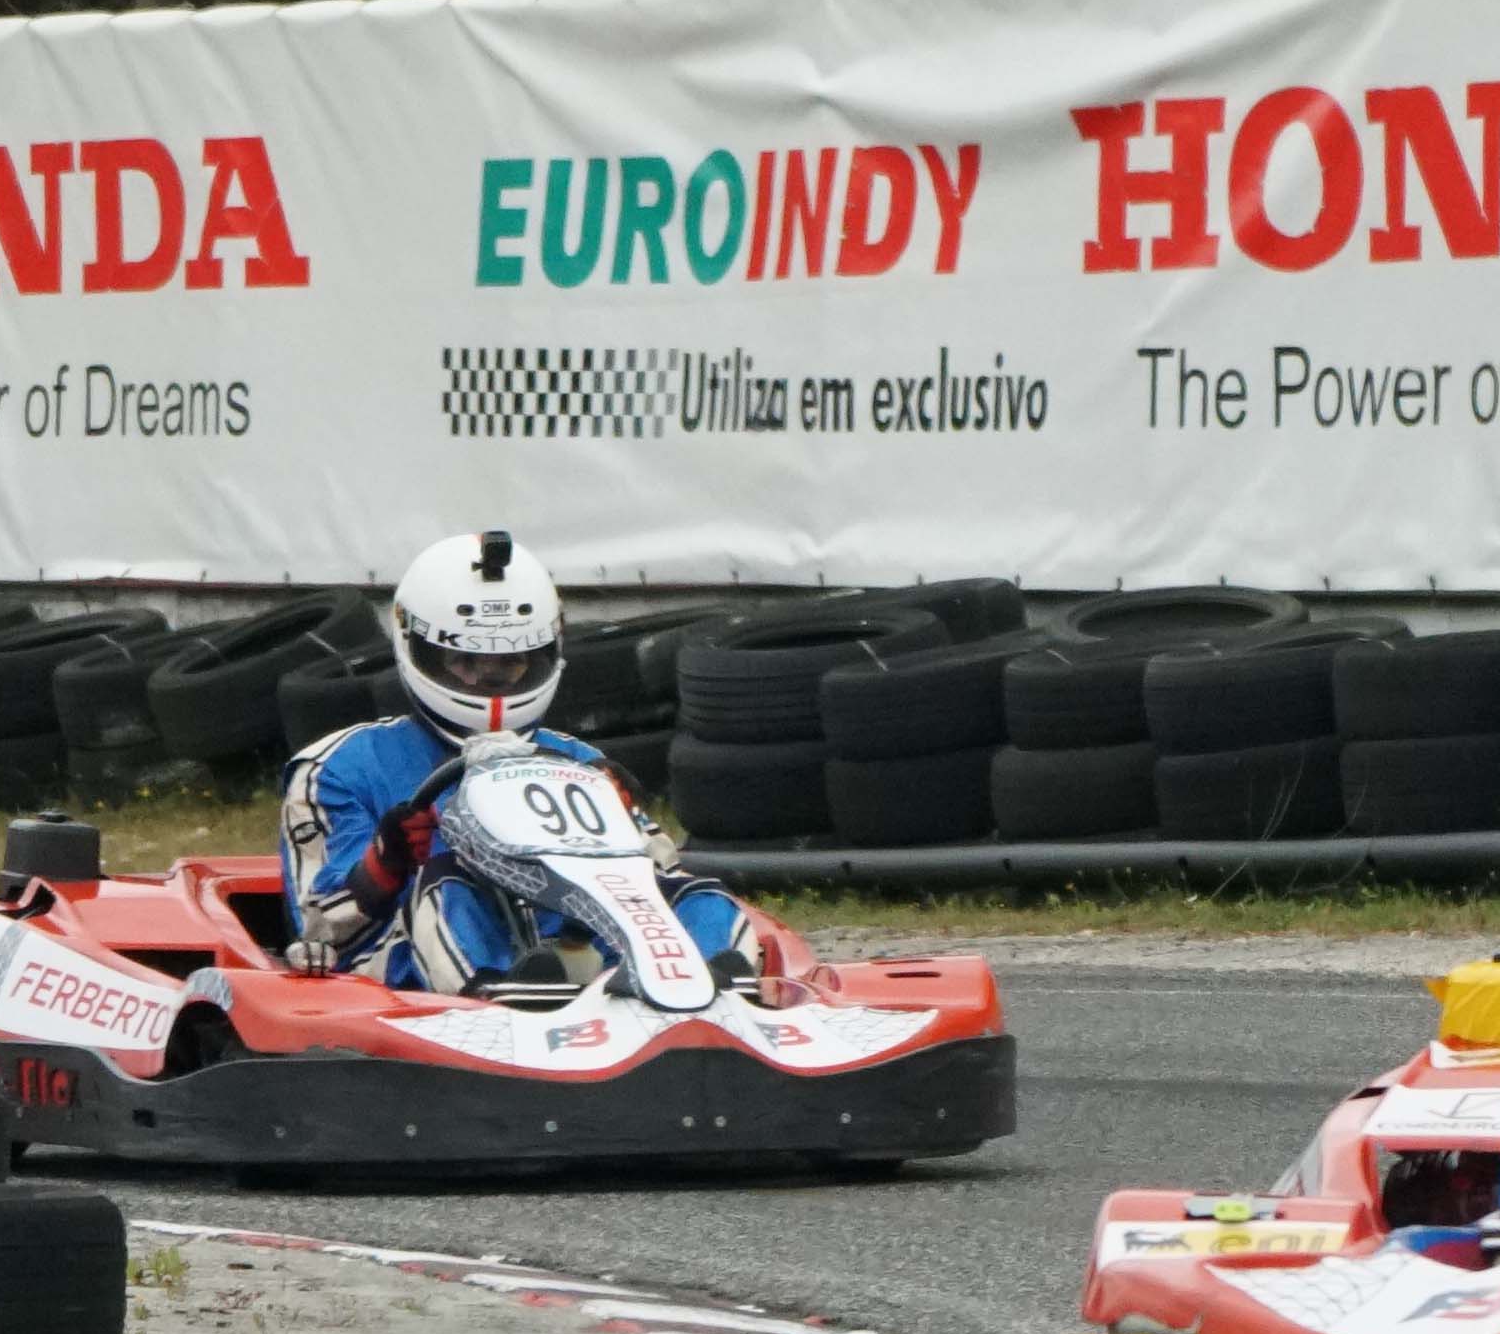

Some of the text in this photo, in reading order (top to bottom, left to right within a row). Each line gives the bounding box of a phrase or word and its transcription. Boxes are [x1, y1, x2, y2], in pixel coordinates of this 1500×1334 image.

[475, 143, 981, 288] EUROINDY
[25, 364, 69, 436] of
[85, 365, 250, 437] Dreams
[680, 347, 1049, 433] Utiliza em exclusivo
[1137, 347, 1247, 429] The
[1274, 346, 1451, 428] Power
[524, 783, 606, 836] 90
[10, 961, 170, 1045] FERBERTO
